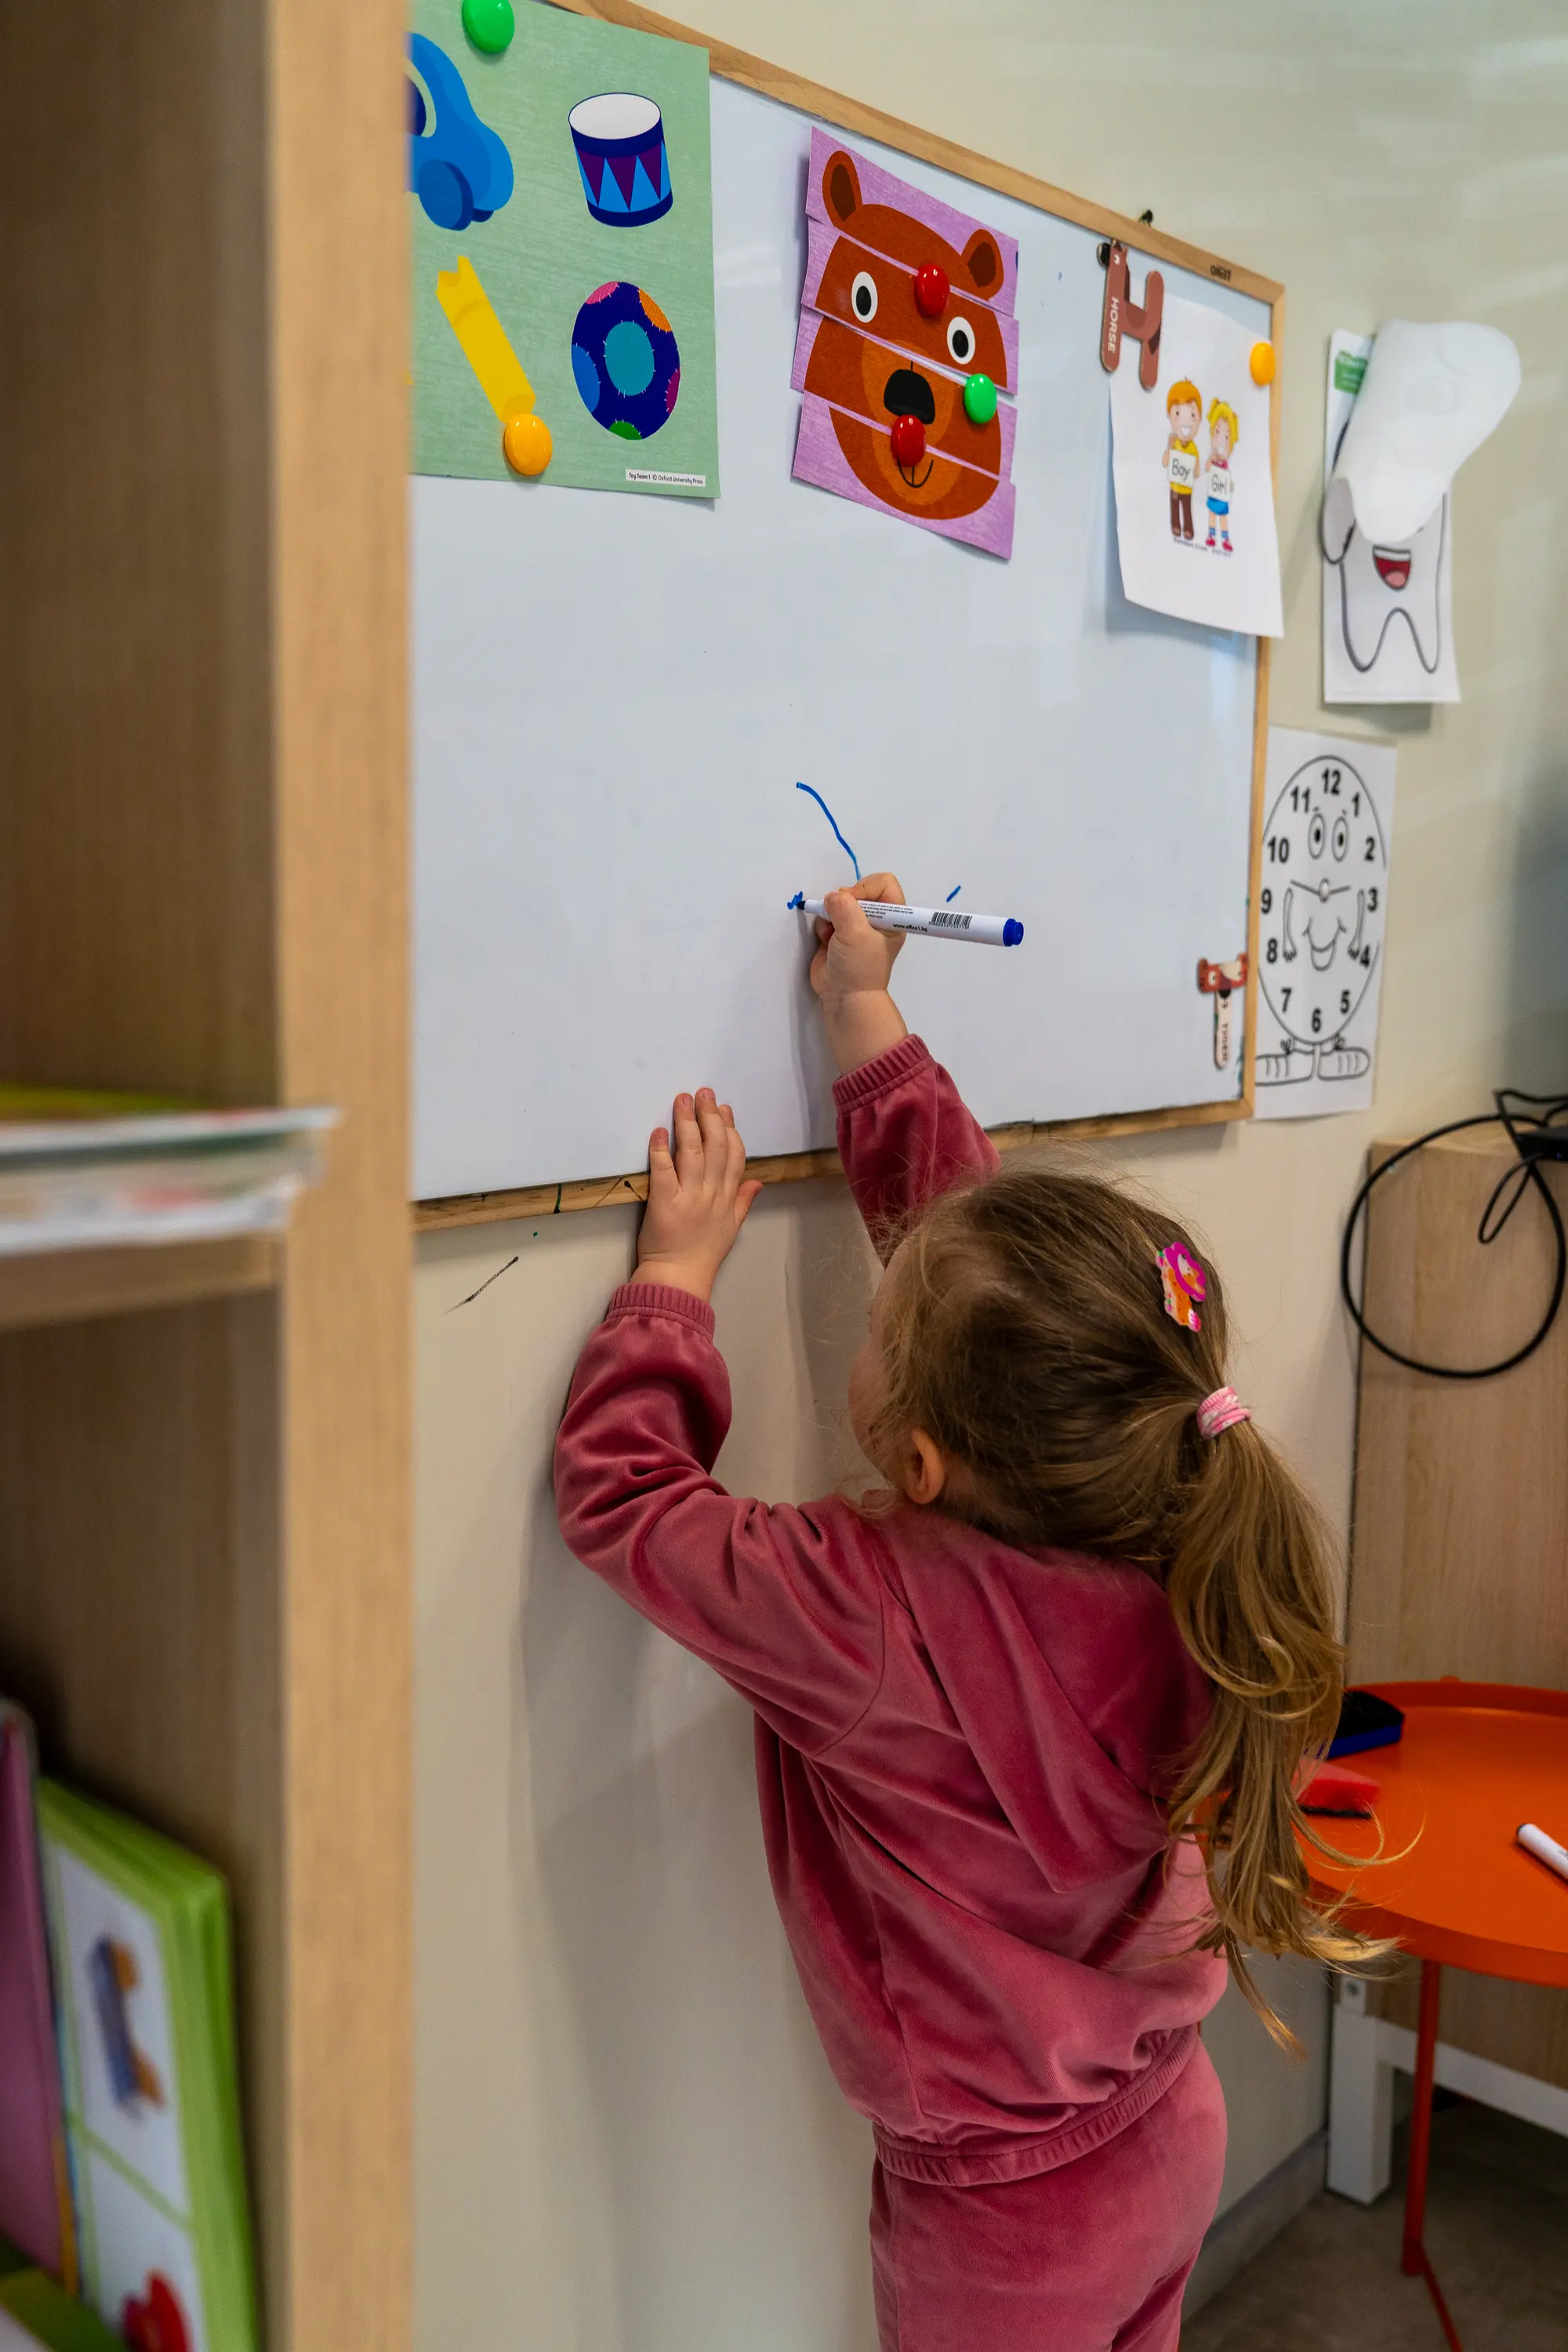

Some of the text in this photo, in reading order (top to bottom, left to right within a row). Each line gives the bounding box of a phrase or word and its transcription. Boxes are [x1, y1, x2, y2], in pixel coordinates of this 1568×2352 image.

[1107, 296, 1120, 353] HORSE
[1172, 458, 1192, 483] Boy
[1211, 474, 1226, 495] Girl
[1322, 768, 1341, 796] 12
[1290, 786, 1310, 813] 11
[1352, 792, 1359, 818] 1
[1268, 837, 1290, 864] 10
[1365, 837, 1375, 861] 2
[1261, 889, 1272, 915] 9
[1367, 887, 1378, 912] 3
[893, 924, 927, 932] www.office1.bg
[1266, 938, 1277, 964] 8
[1360, 946, 1370, 968] 4
[1281, 987, 1292, 1012] 7
[1341, 990, 1350, 1014] 5
[1312, 1007, 1321, 1033] 6
